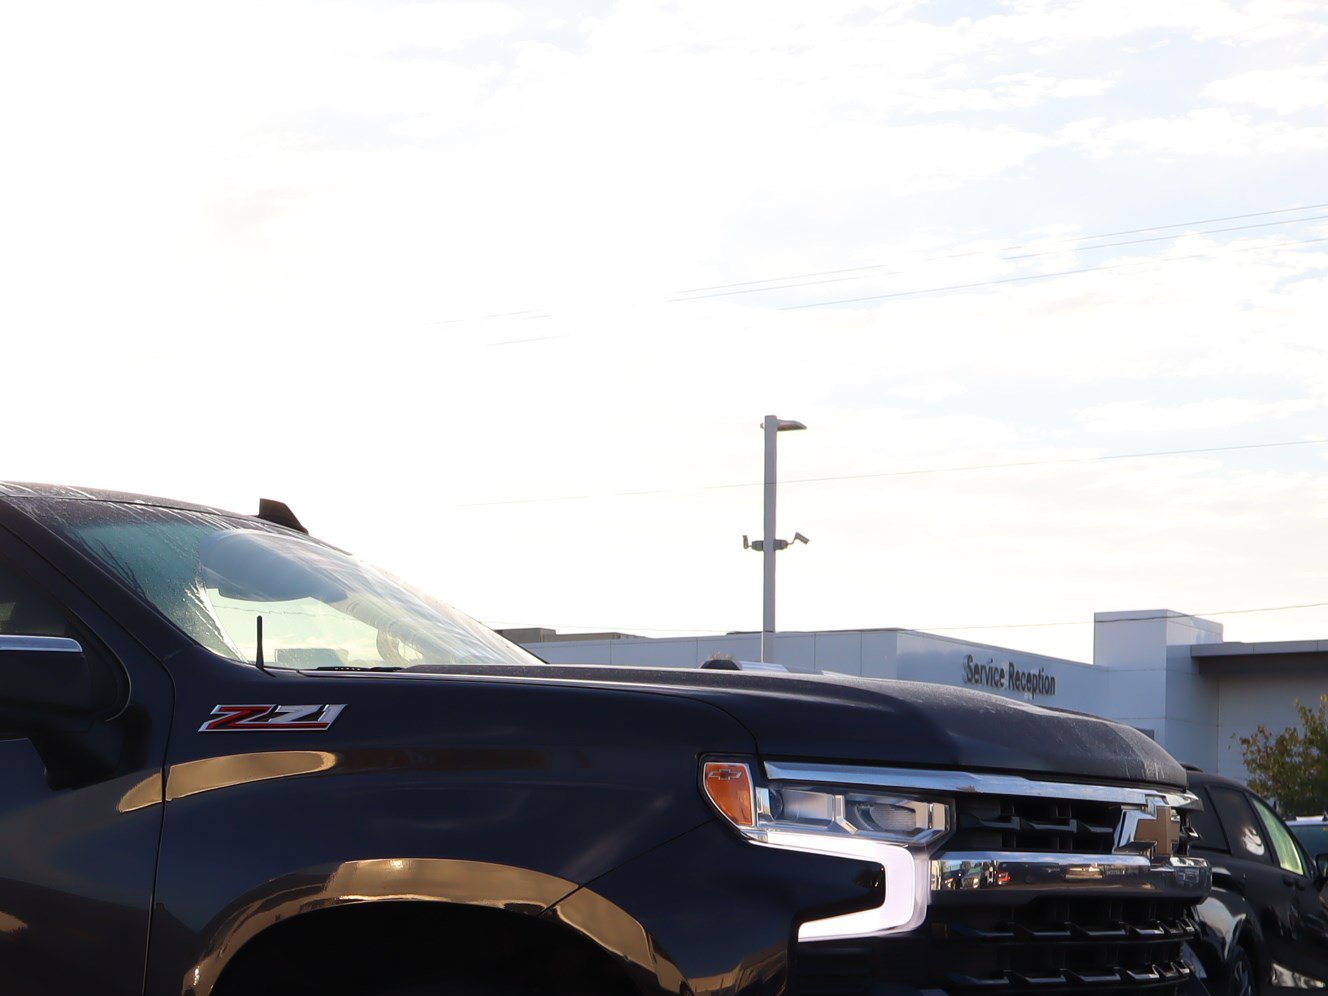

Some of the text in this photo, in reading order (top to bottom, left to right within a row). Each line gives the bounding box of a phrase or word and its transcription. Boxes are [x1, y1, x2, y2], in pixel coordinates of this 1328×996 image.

[965, 654, 1056, 699] Service Reception
[197, 703, 348, 733] Z71
